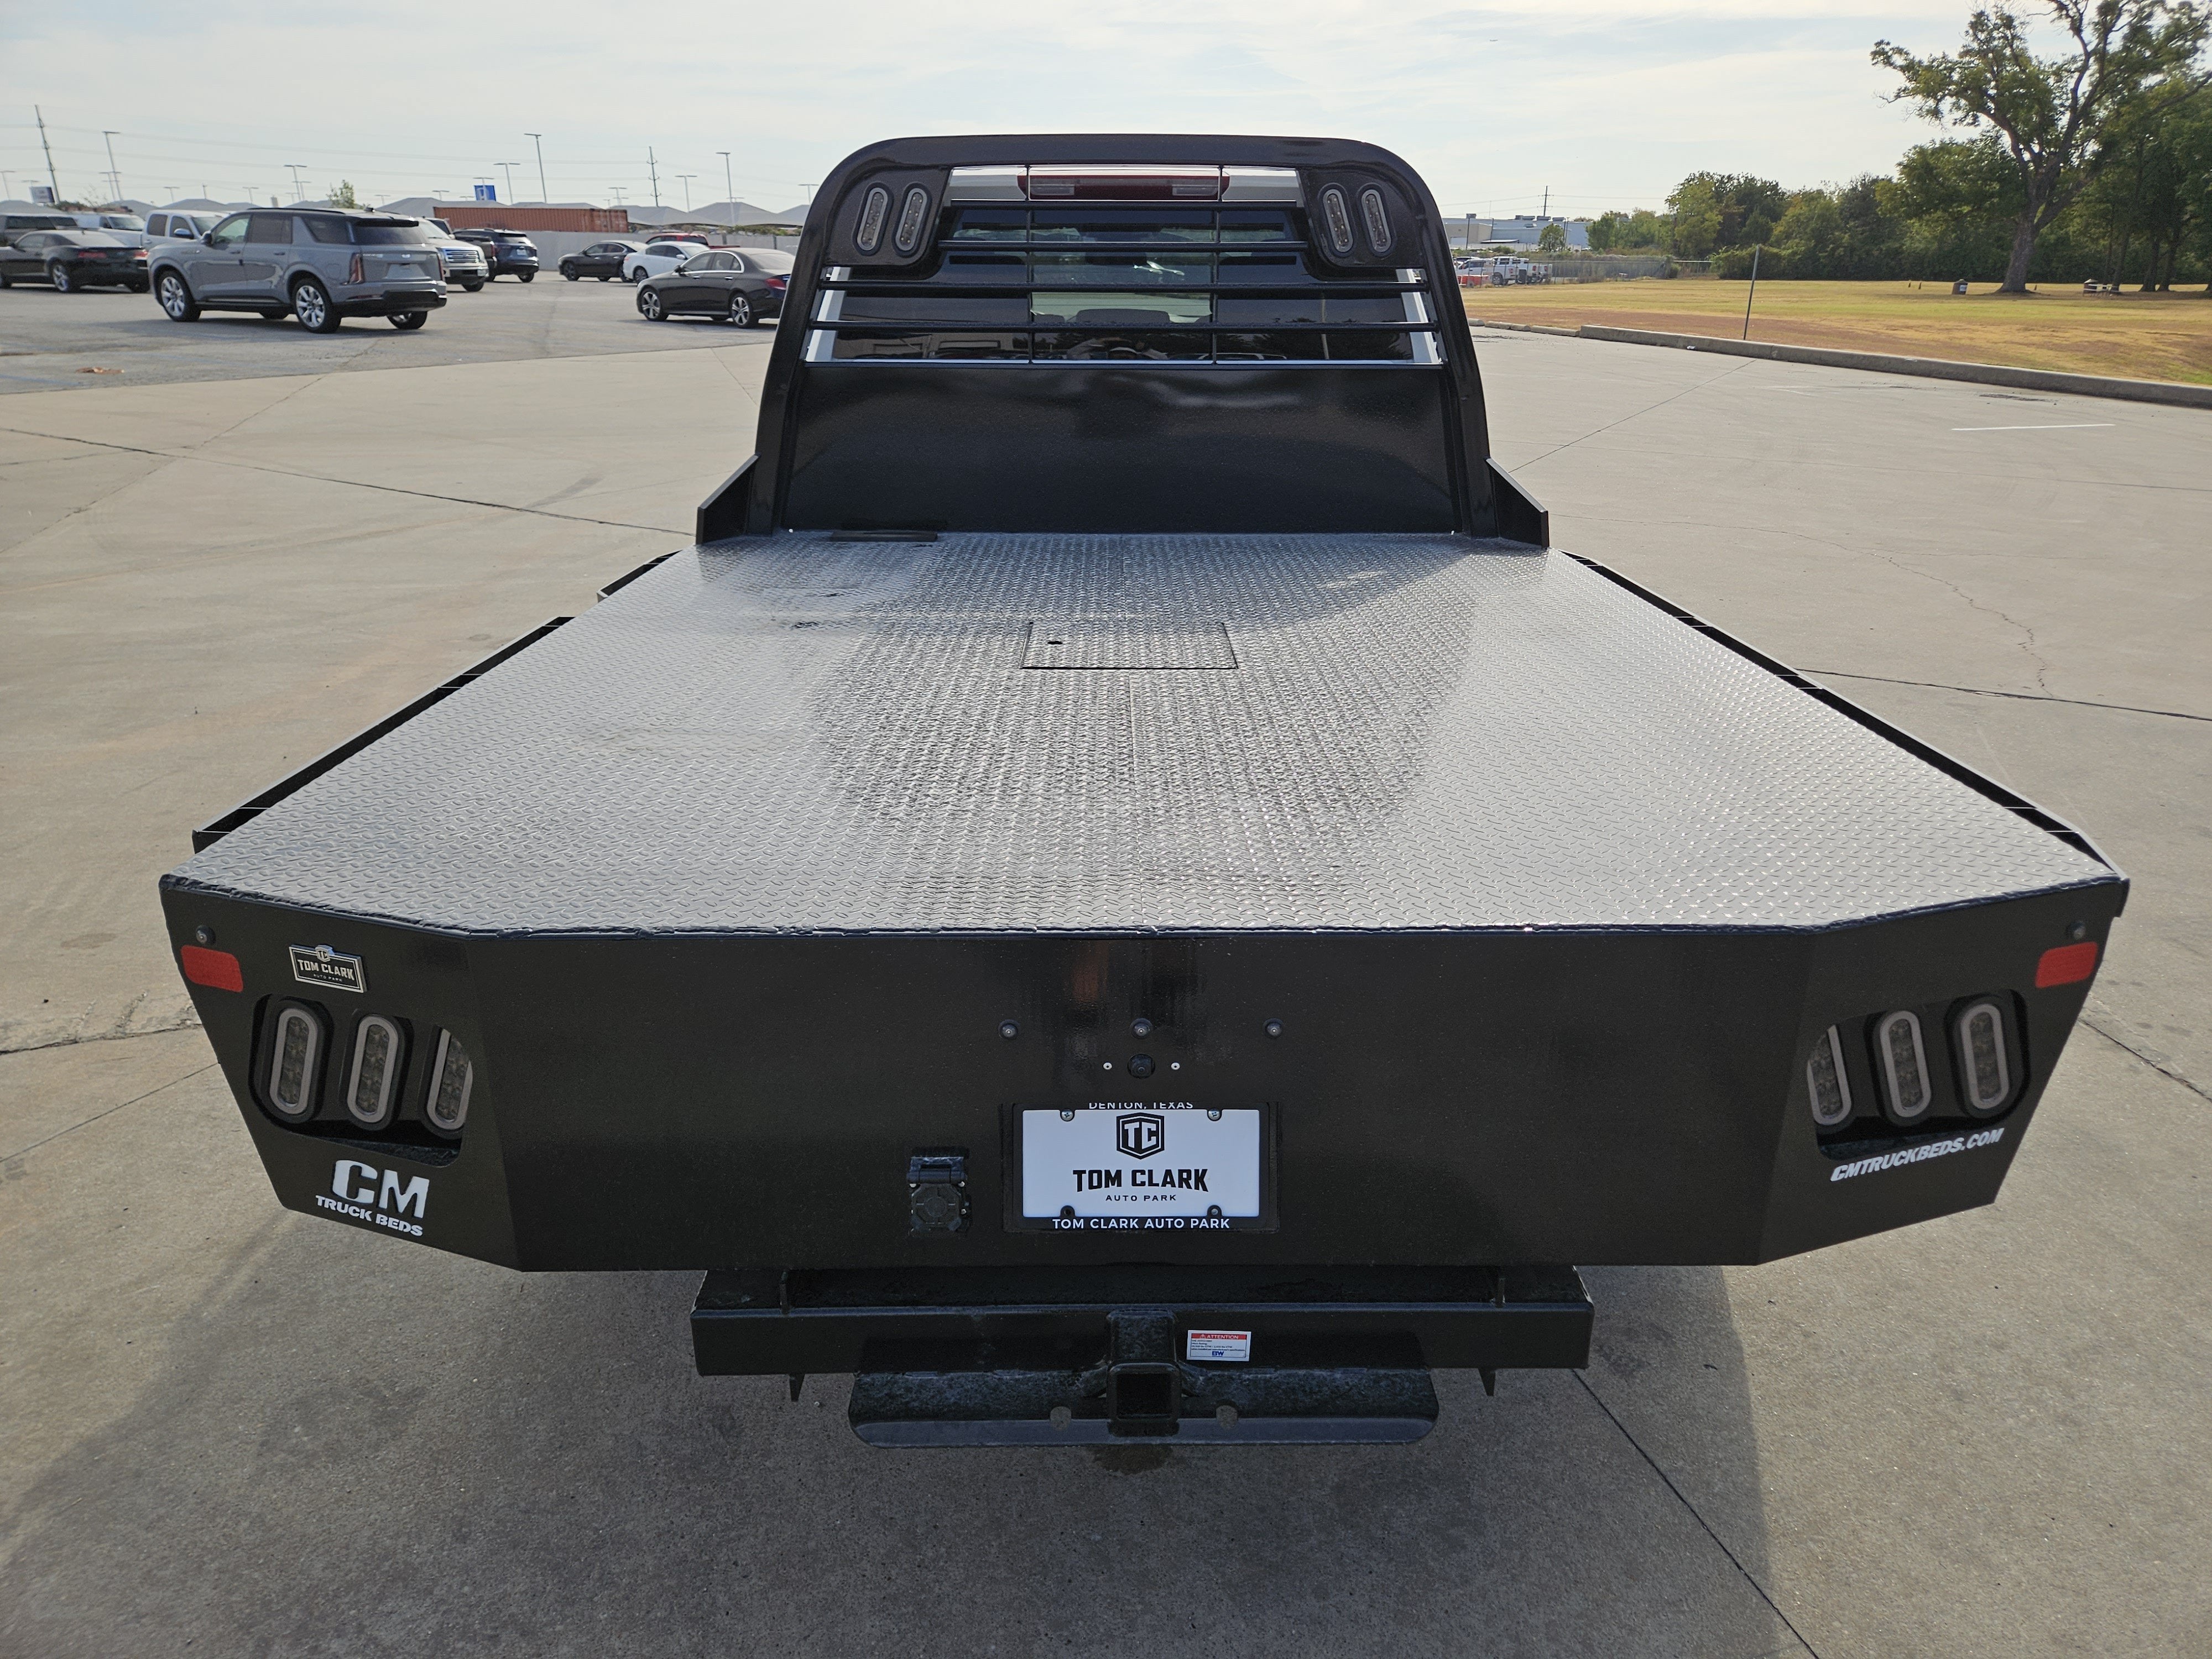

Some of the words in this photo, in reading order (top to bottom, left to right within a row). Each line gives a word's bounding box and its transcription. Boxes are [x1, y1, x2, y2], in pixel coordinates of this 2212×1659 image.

[297, 959, 319, 971] TOM
[321, 963, 354, 980] CLARK
[1124, 1121, 1156, 1150] TC
[1830, 1128, 2005, 1181] CMTRUCKBEDS.COM
[332, 1160, 430, 1218] CM
[1073, 1169, 1122, 1192] TOM
[1131, 1168, 1209, 1192] CLARK
[315, 1195, 373, 1222] TRUCK
[375, 1214, 423, 1237] BEDS
[1052, 1218, 1084, 1229] TOM
[1090, 1218, 1139, 1229] CLARK
[1144, 1218, 1184, 1229] AUTO
[1191, 1218, 1230, 1229] PARK
